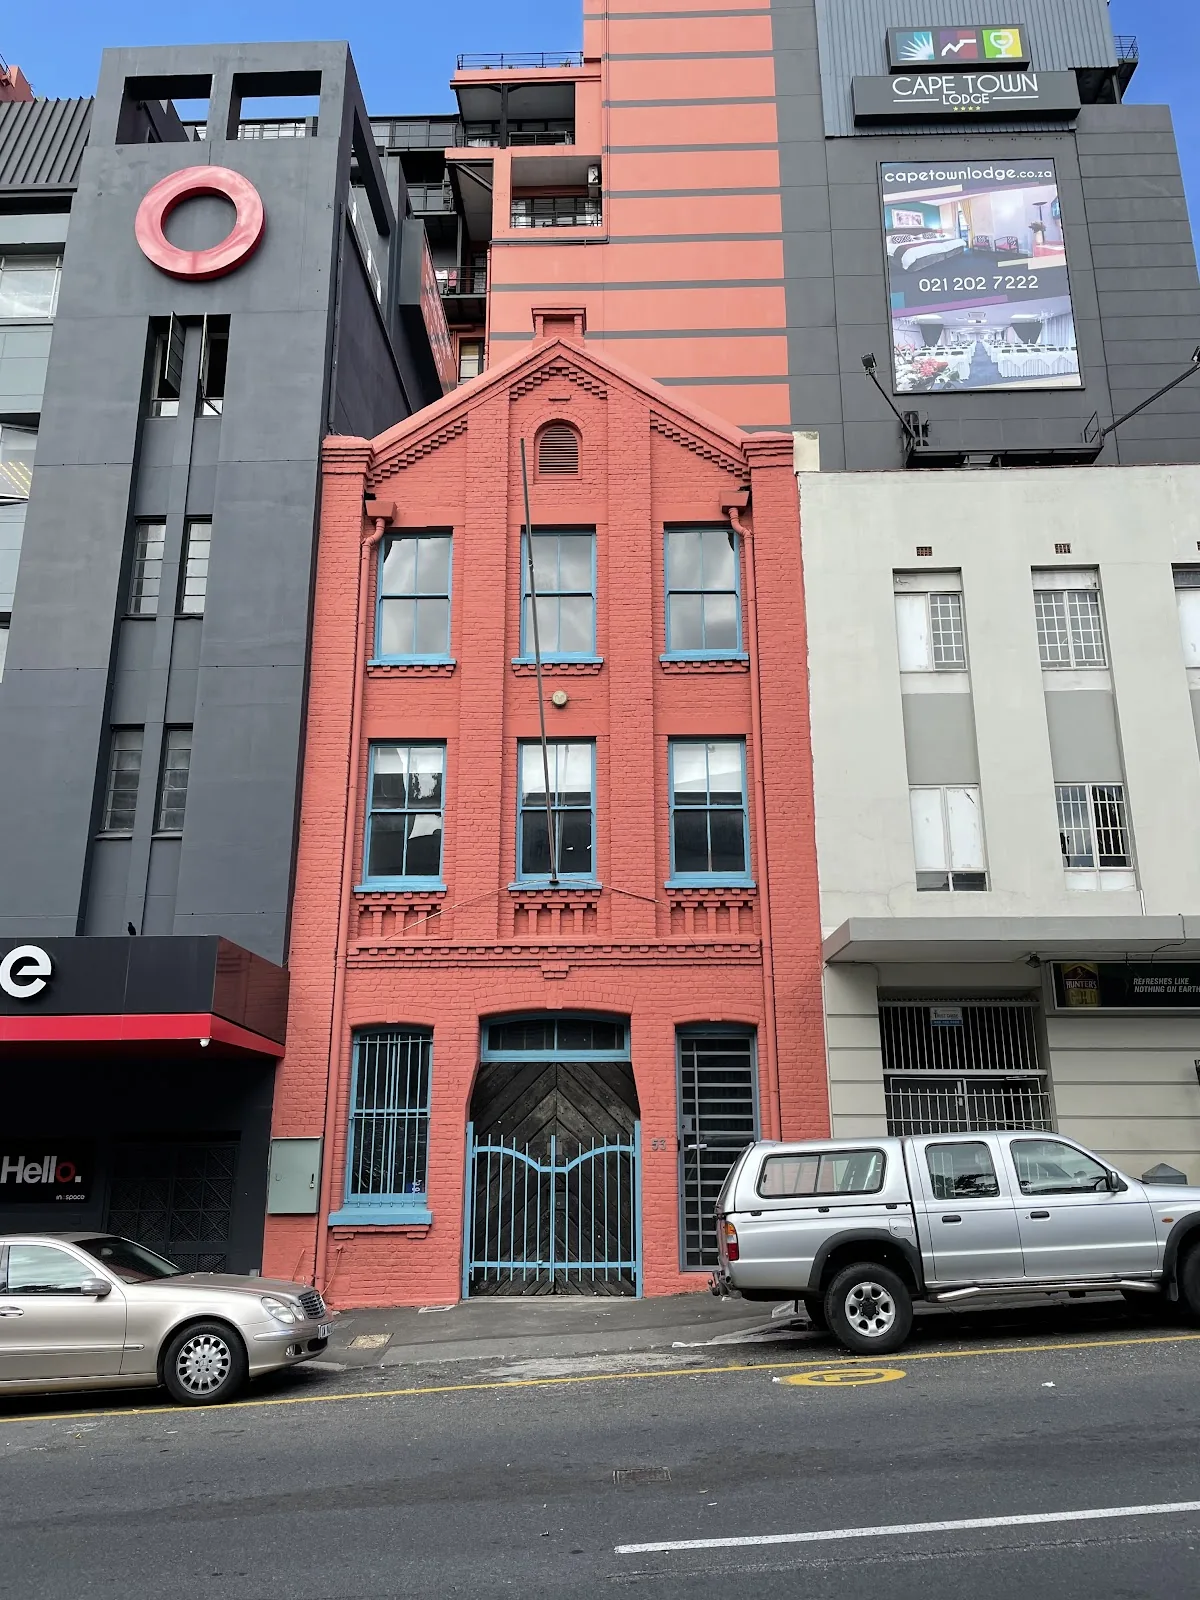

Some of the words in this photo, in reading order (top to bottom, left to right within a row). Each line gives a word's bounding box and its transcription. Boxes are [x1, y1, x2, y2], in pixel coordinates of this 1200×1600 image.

[892, 75, 956, 96] CAPE
[963, 73, 1039, 94] TOWN
[942, 94, 990, 105] LODGE
[884, 166, 1053, 184] capetownlodge.co.za
[918, 278, 948, 292] 021
[953, 276, 987, 291] 202
[992, 275, 1039, 290] 7222
[1133, 977, 1173, 985] REFRESHES
[1174, 977, 1190, 985] LIKE
[1134, 985, 1166, 993] NOTHING
[1166, 985, 1178, 993] ON
[1178, 985, 1200, 993] EARTH
[651, 1138, 667, 1151] 53
[0, 1155, 82, 1184] Hello.
